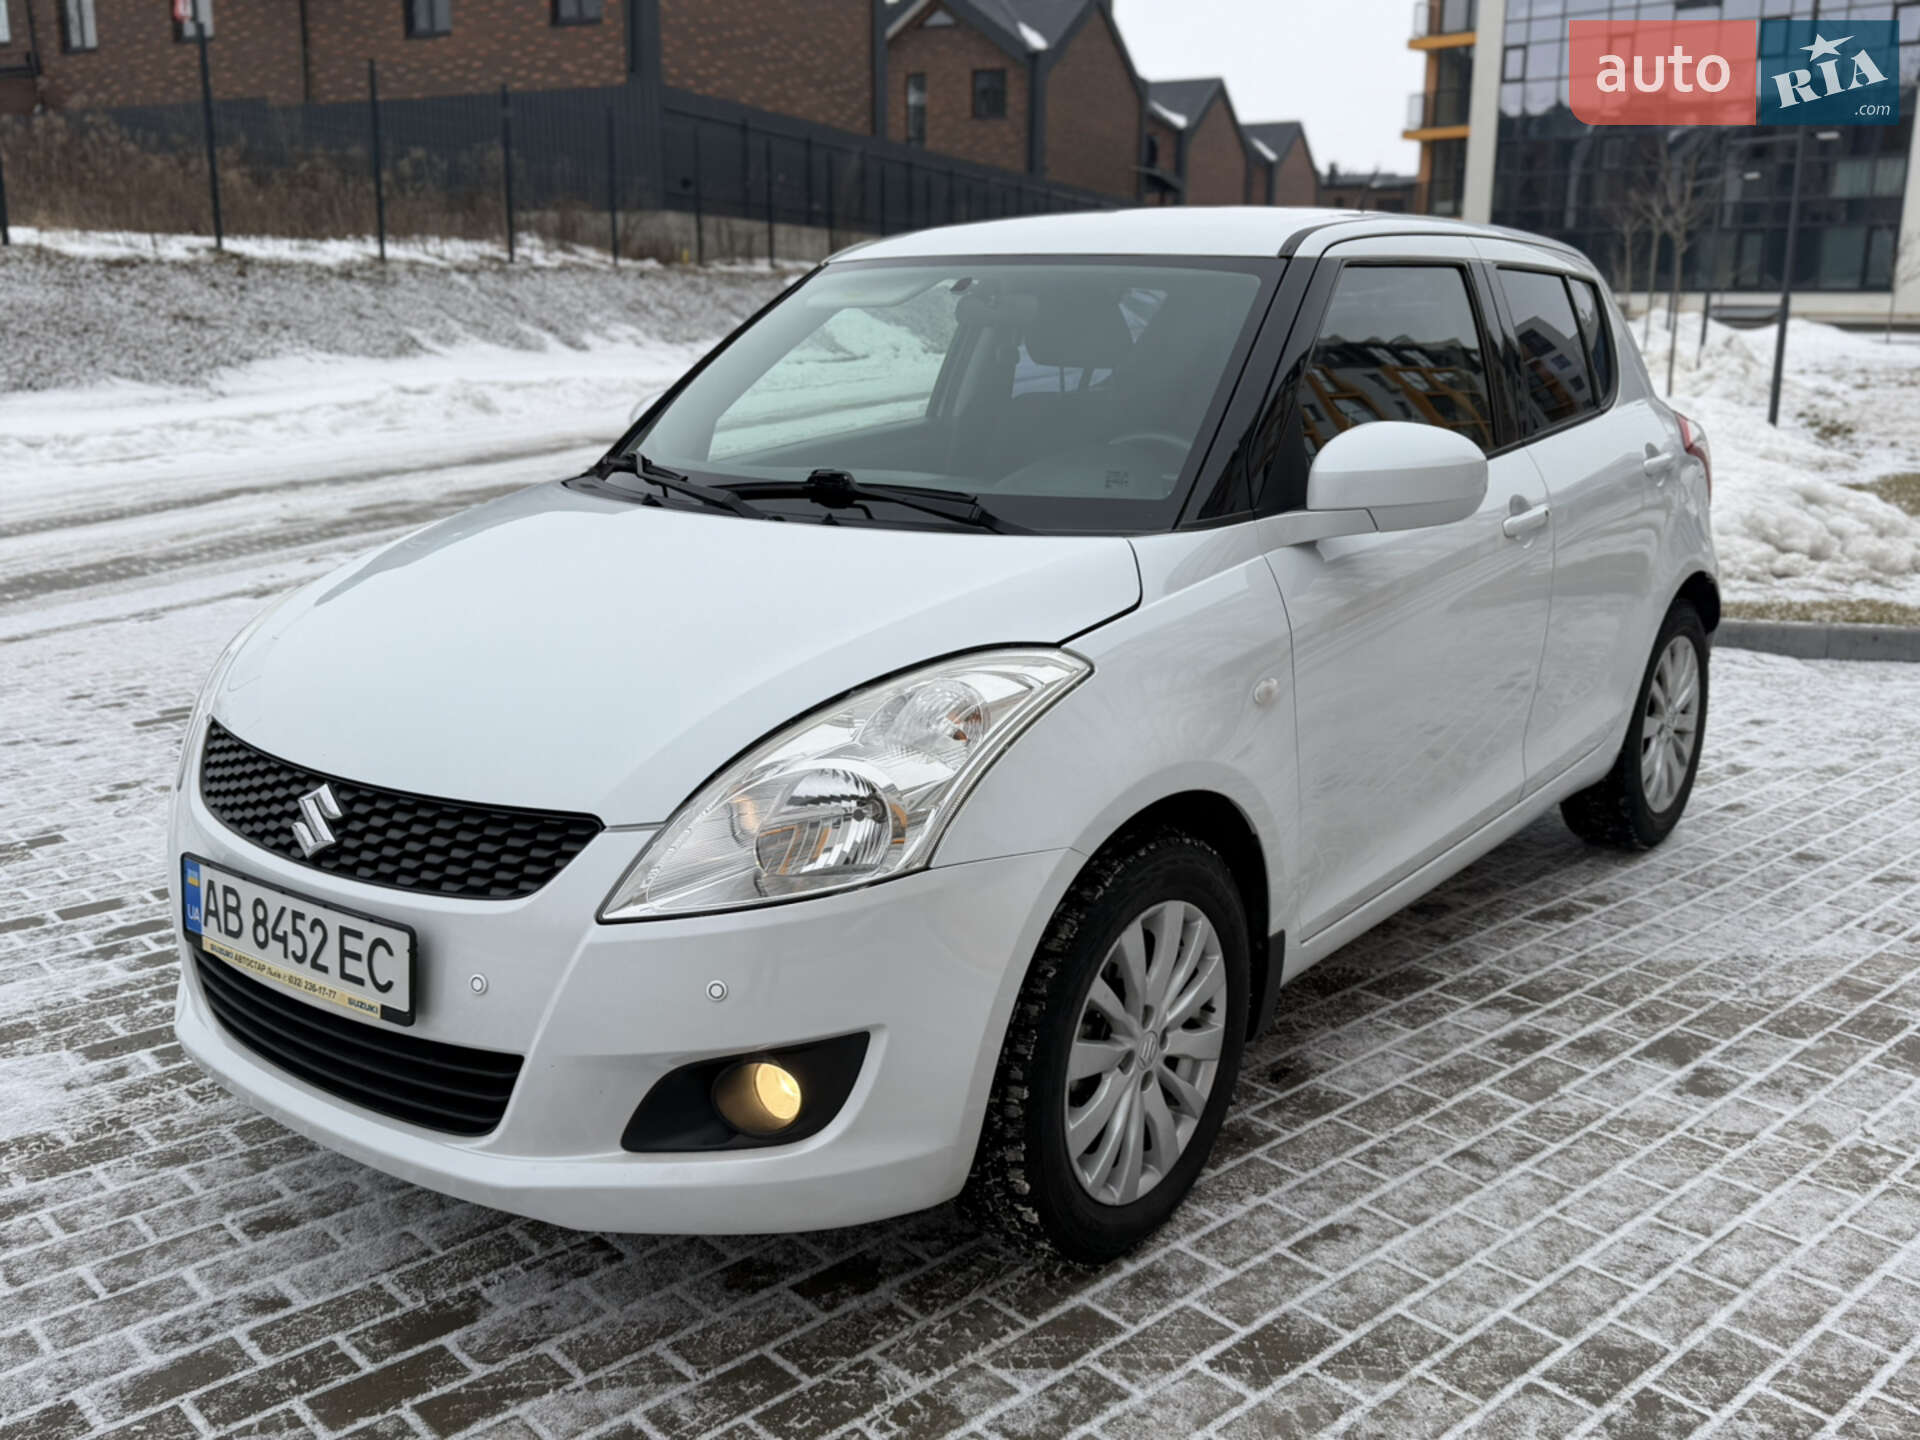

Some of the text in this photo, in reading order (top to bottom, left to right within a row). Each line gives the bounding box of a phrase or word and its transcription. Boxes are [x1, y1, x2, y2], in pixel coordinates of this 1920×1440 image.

[187, 903, 201, 922] UA
[203, 879, 394, 993] AB 8452 EC
